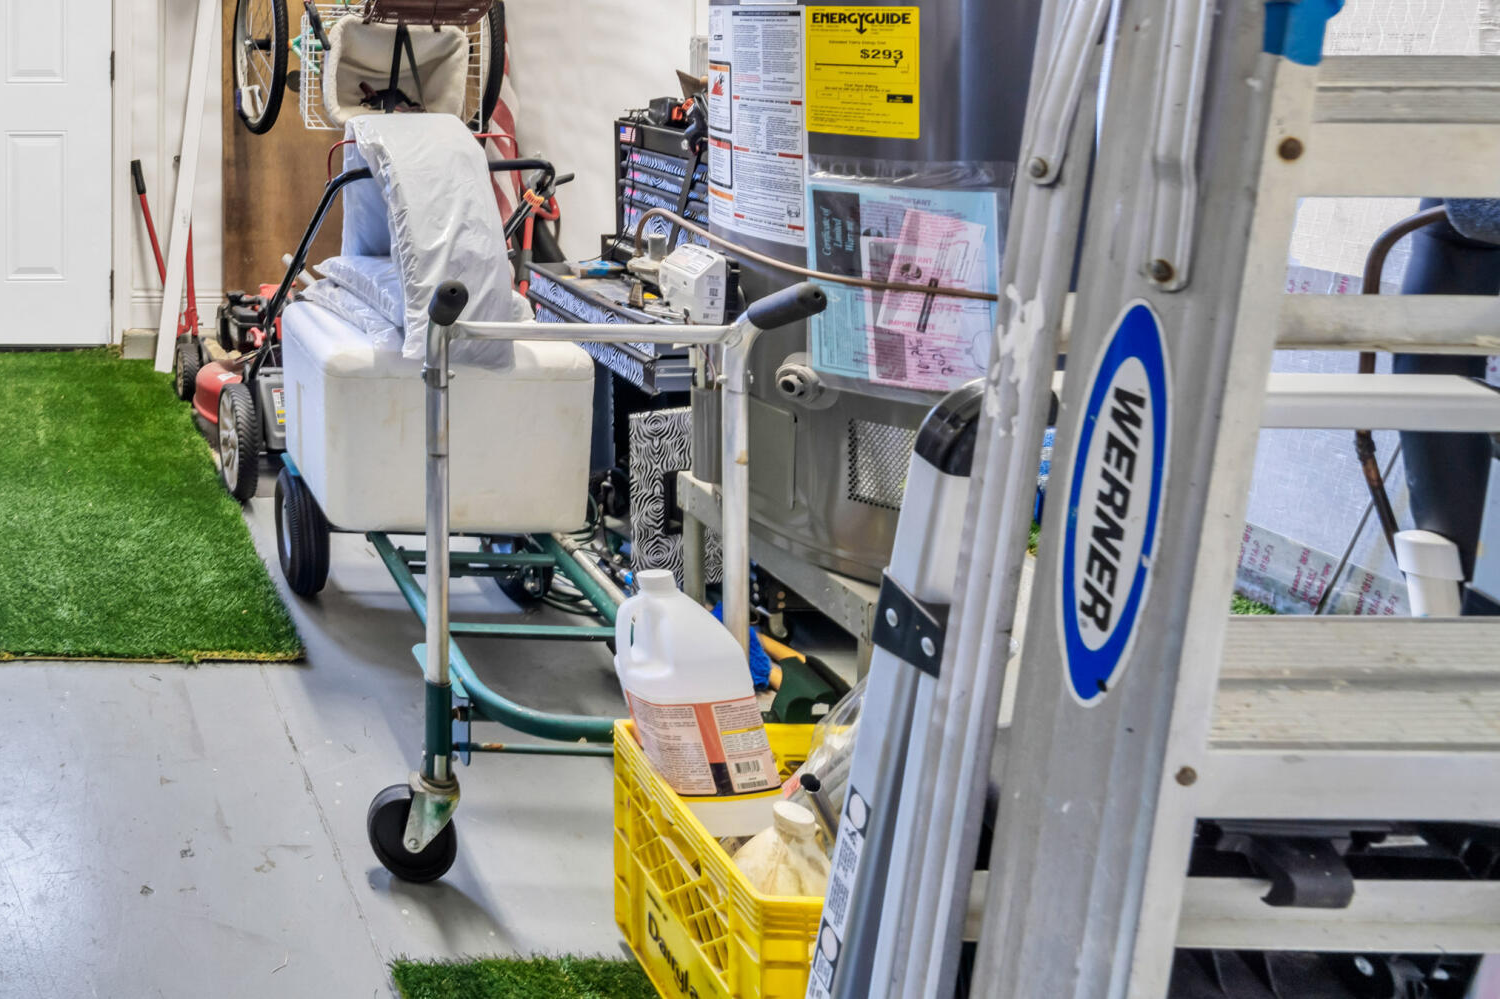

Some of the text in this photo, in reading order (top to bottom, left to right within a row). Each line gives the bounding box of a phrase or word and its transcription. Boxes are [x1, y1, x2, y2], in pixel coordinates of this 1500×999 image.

[812, 12, 912, 28] ENERGYGUIDE
[859, 48, 904, 61] $293
[1080, 386, 1147, 634] WERNER
